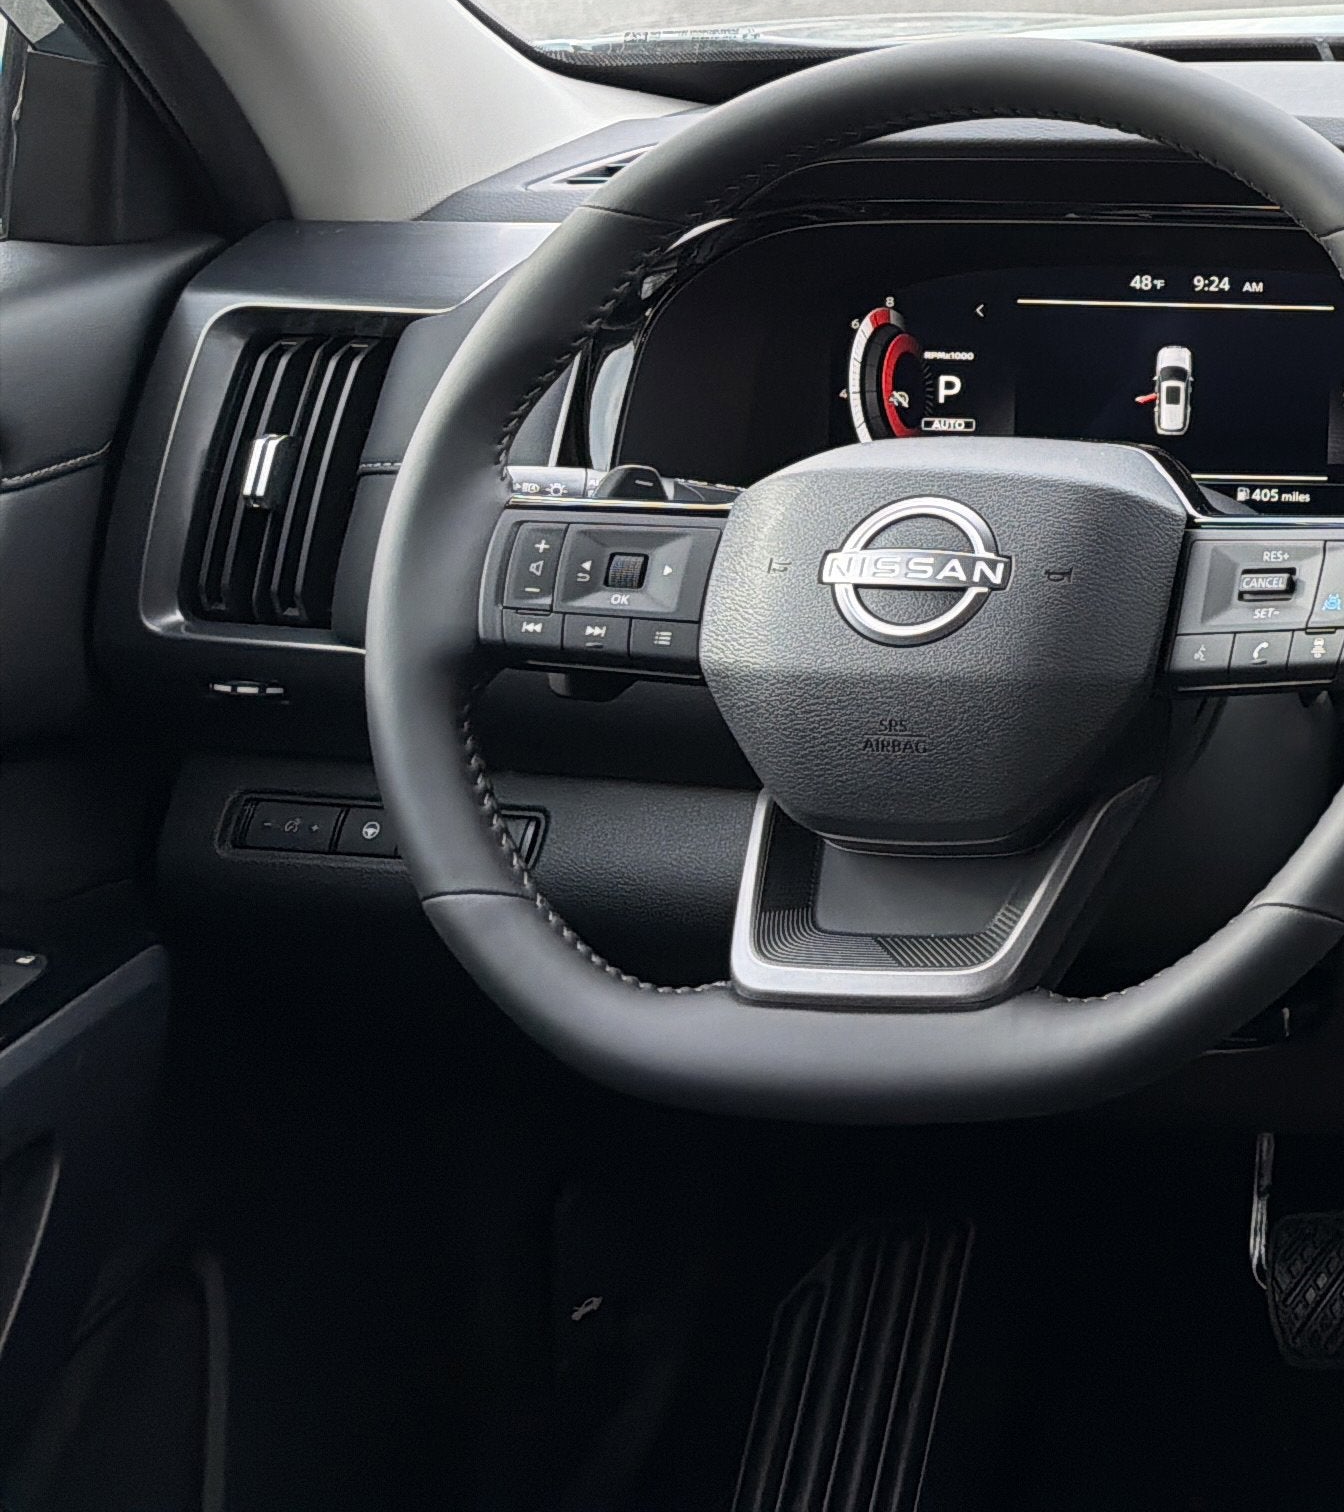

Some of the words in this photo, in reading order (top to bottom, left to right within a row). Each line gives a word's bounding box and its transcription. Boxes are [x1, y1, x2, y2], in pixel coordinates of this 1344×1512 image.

[1193, 275, 1230, 292] 9:24
[1242, 281, 1264, 293] AM
[885, 296, 895, 307] 8
[850, 318, 860, 330] 6
[839, 388, 848, 399] 4
[938, 375, 962, 404] P
[932, 420, 965, 430] AUTO
[1251, 488, 1279, 502] 405
[1281, 490, 1311, 503] miles
[1262, 551, 1290, 562] RES+
[829, 556, 1005, 584] NISSAN
[1242, 576, 1286, 589] CANCEL
[610, 593, 630, 605] OK
[862, 739, 928, 754] AIRBAG
